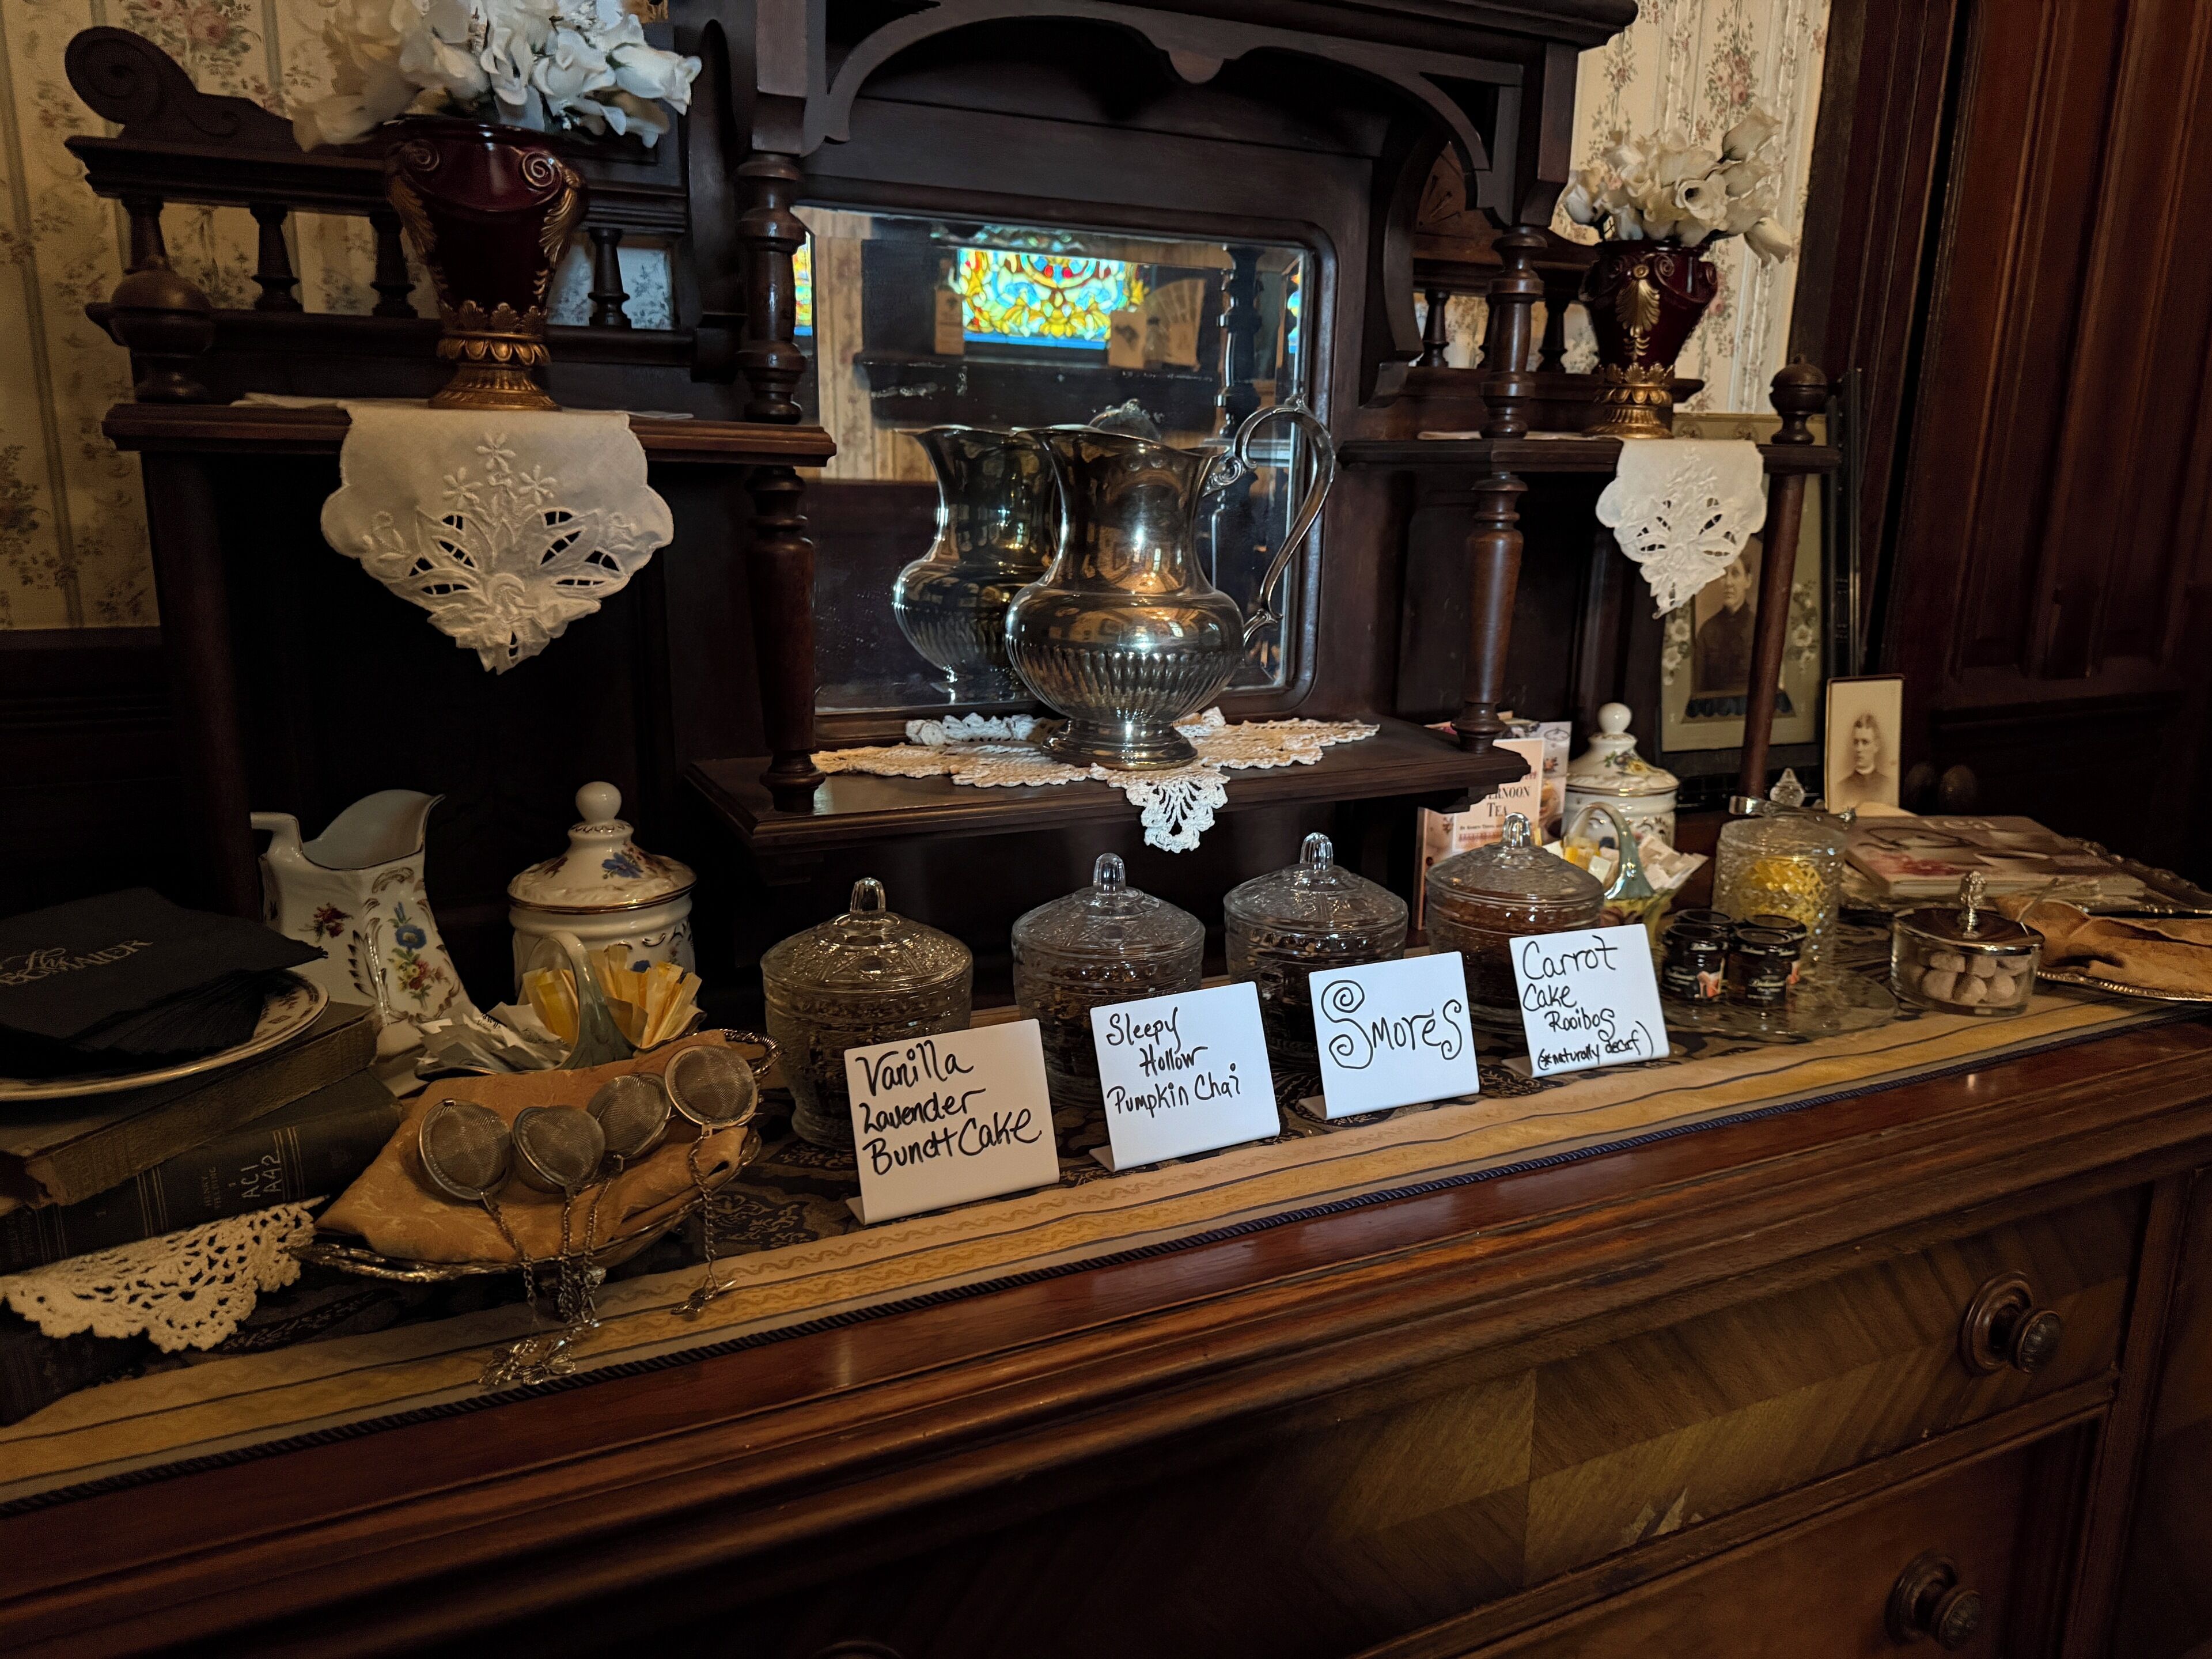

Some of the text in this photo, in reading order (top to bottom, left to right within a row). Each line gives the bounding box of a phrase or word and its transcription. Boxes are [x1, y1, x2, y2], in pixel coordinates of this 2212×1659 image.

[1522, 934, 1618, 979] Carrot
[1522, 983, 1577, 1012] Cake
[1106, 1006, 1181, 1054] Sleepy
[1544, 1007, 1615, 1042] Rooibos
[855, 1039, 974, 1096] Vanilla
[1139, 1044, 1208, 1077] Hollow
[859, 1088, 986, 1134] Lavender
[1107, 1063, 1240, 1118] Pumpkin Chai
[958, 1108, 1042, 1156] Cake
